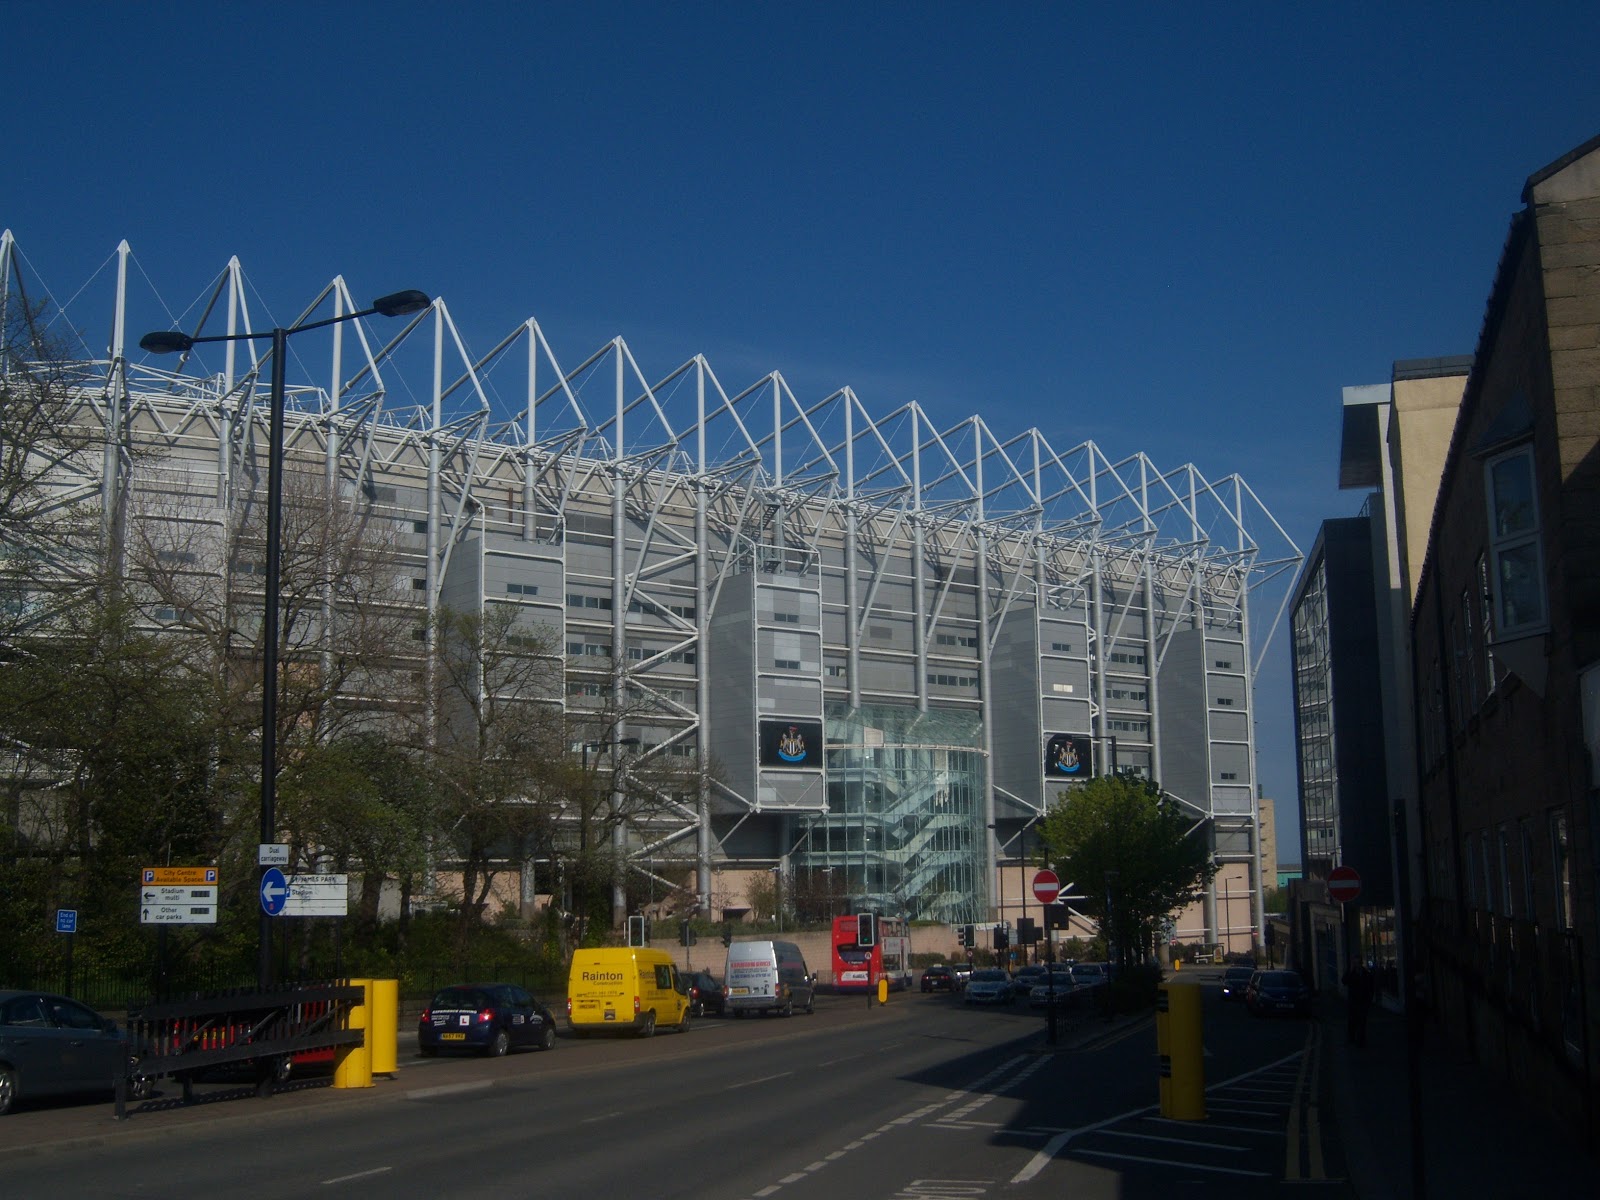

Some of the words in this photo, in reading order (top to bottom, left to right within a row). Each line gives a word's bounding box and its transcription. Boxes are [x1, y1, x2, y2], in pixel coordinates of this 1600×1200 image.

[268, 846, 280, 854] Dual
[260, 855, 287, 863] carriageway
[582, 971, 623, 981] Rainton
